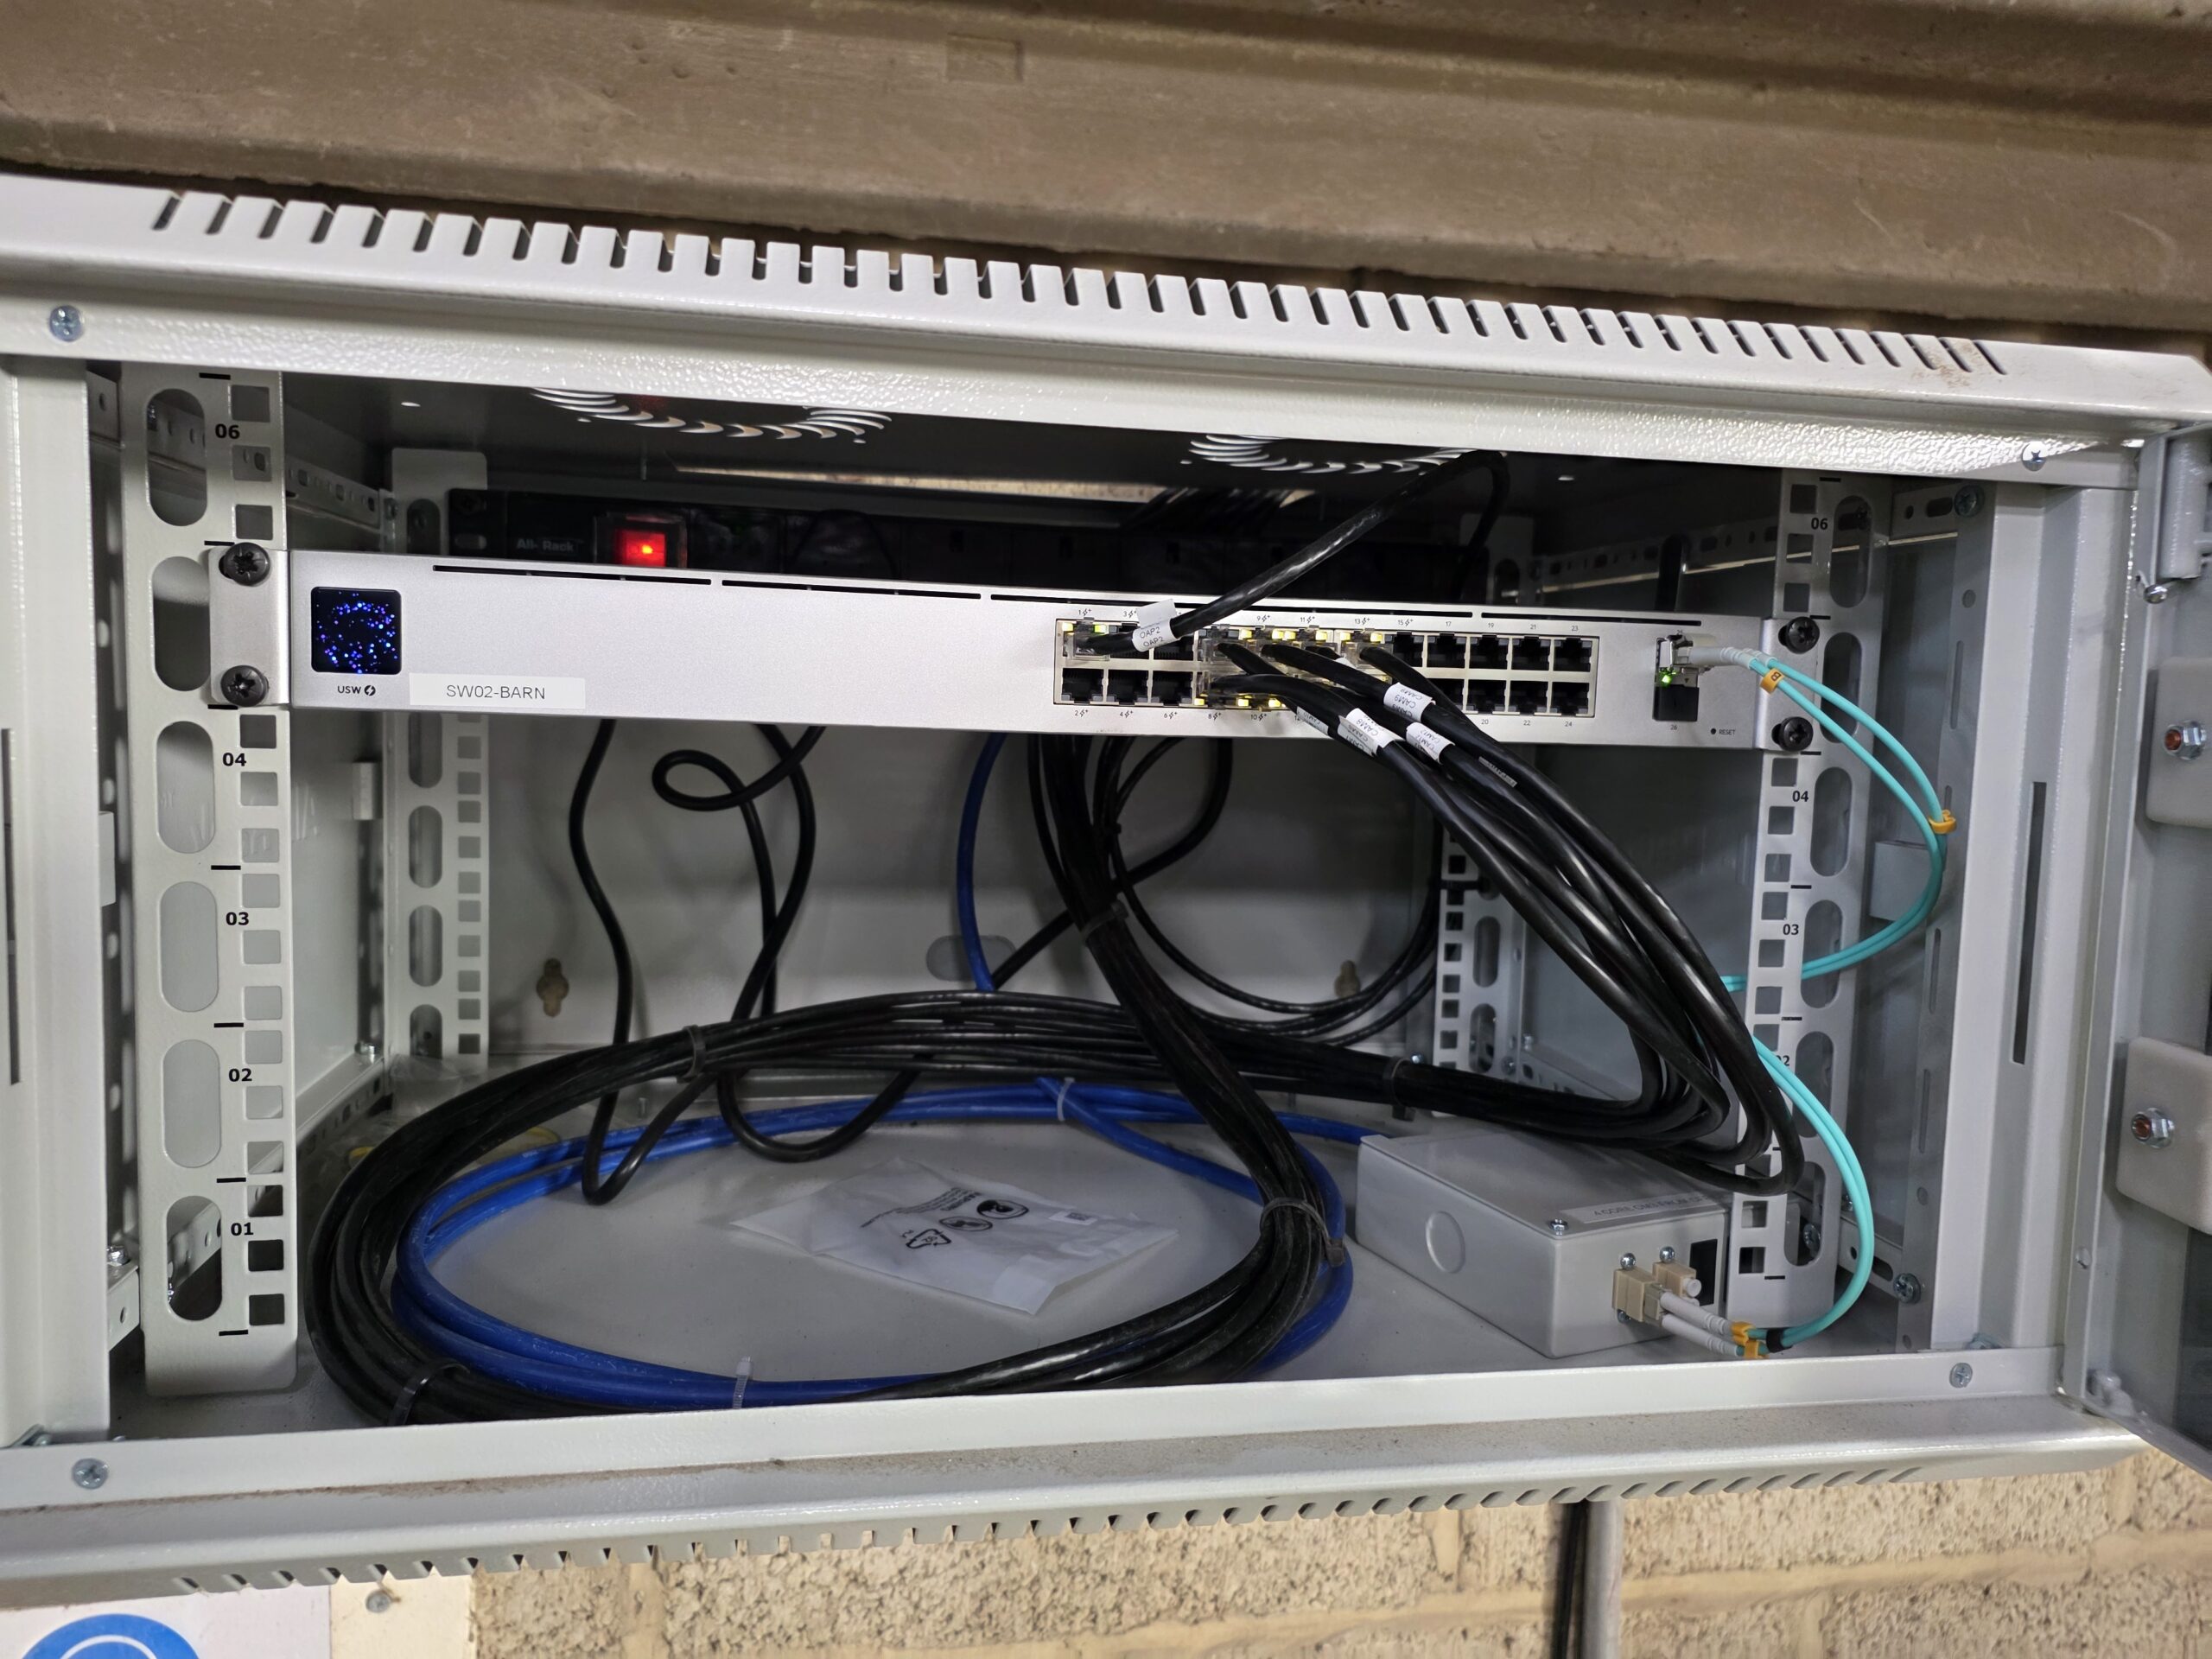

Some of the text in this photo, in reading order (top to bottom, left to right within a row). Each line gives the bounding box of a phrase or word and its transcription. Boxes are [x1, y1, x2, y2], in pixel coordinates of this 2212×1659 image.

[214, 423, 240, 440] 06
[1810, 517, 1828, 531] 06
[1139, 626, 1161, 639] OAP2
[1142, 636, 1165, 648] OAP2
[1770, 671, 1782, 682] B
[337, 685, 361, 695] USW
[445, 684, 546, 700] SW02-BARN
[1394, 694, 1416, 709] CAM9
[1356, 718, 1379, 736] CAM8
[222, 751, 247, 767] 04
[1791, 790, 1809, 803] 04
[226, 911, 251, 927] 03
[1782, 923, 1799, 936] 03
[227, 1067, 253, 1084] 02
[230, 1221, 255, 1237] 01
